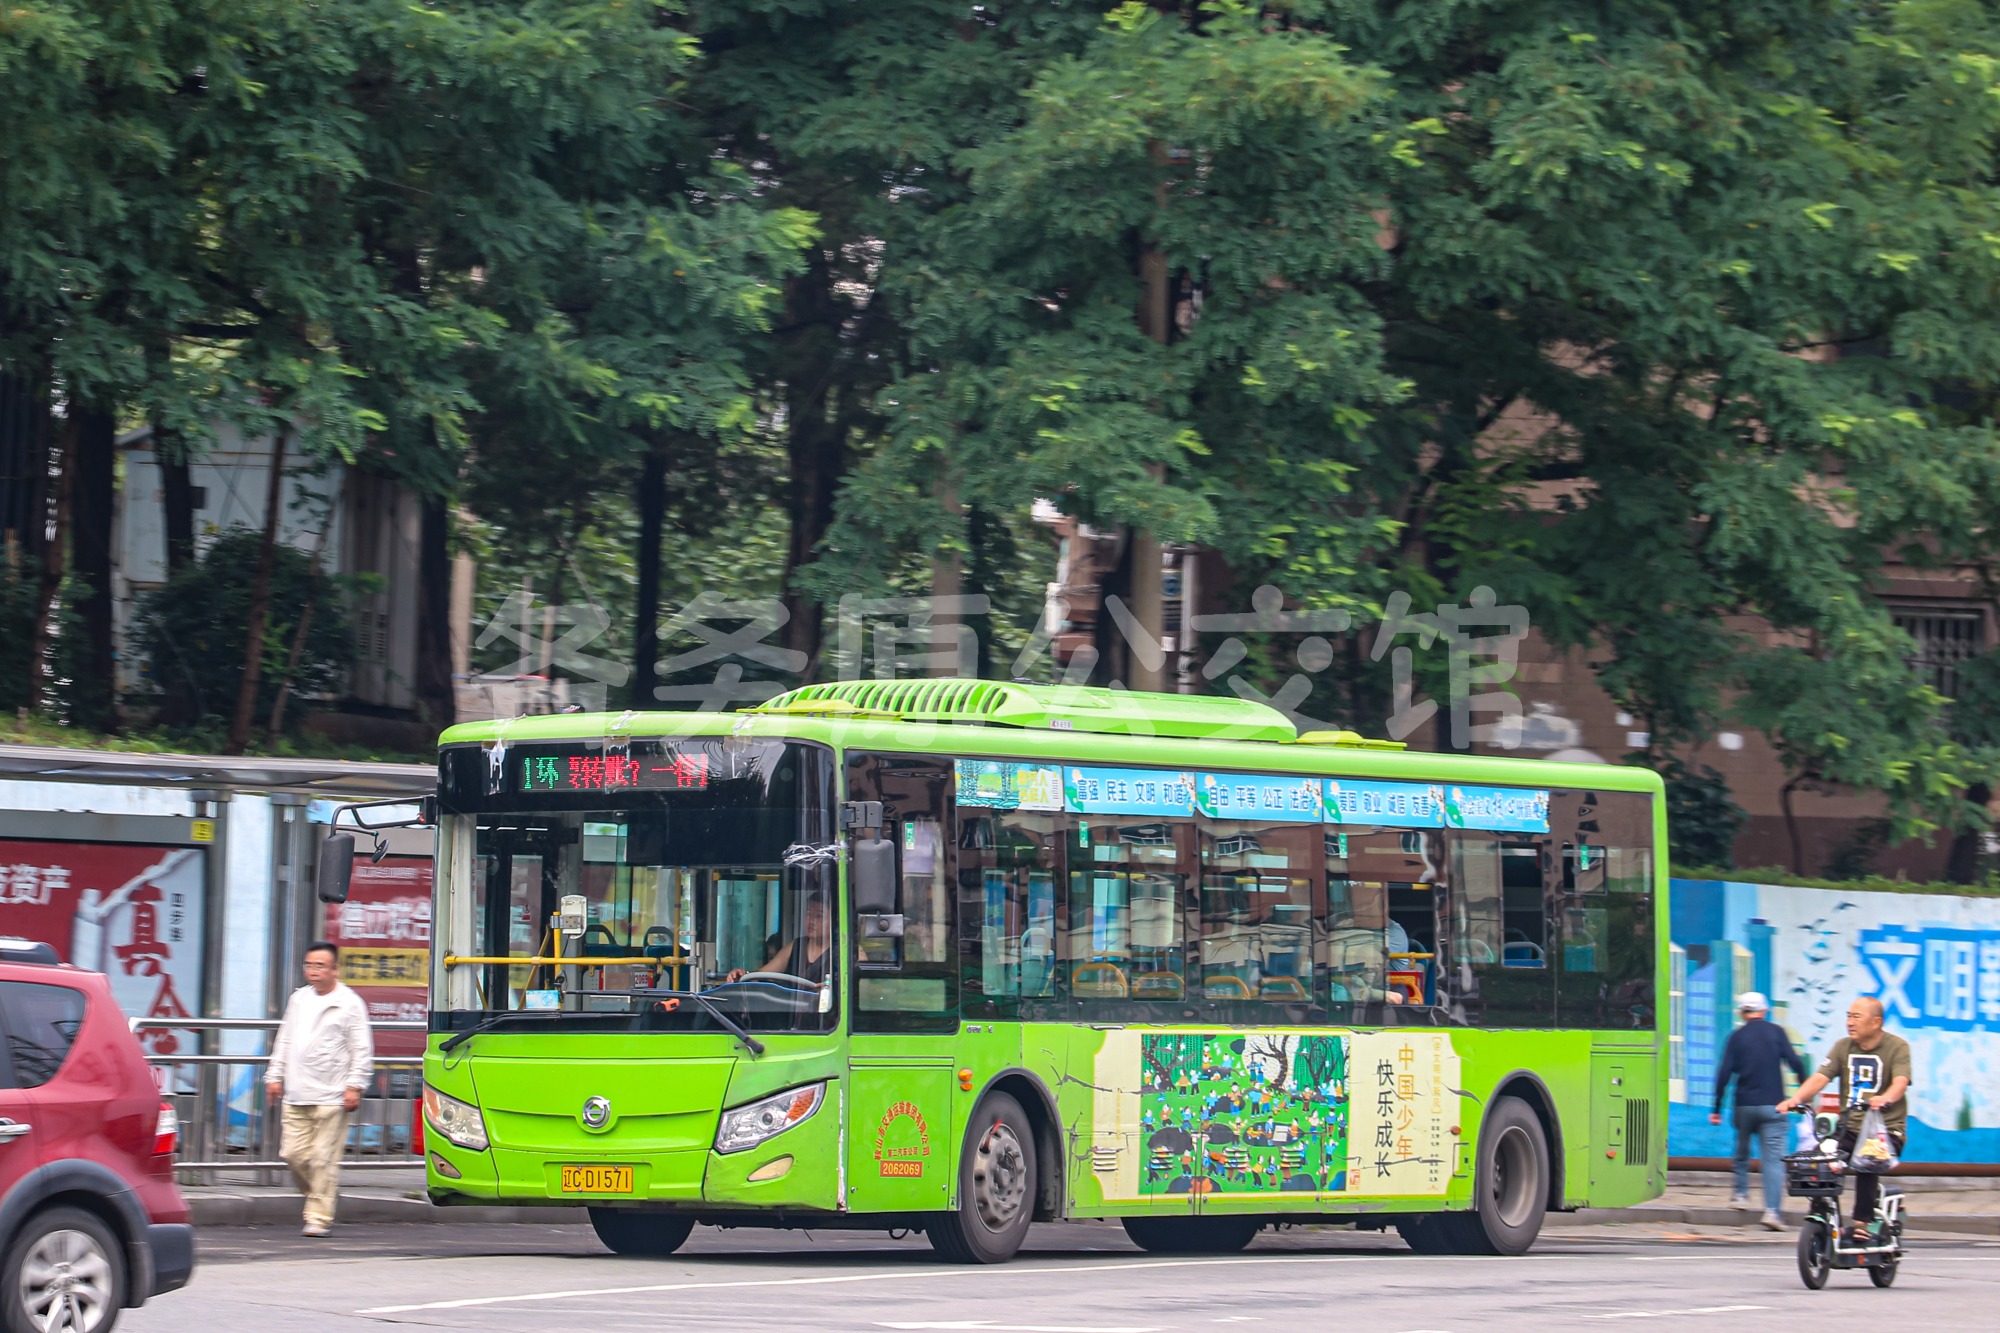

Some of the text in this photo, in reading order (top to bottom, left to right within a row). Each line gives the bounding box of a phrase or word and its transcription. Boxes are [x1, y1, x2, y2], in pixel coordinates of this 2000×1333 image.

[1077, 780, 1099, 801] 富强
[1107, 781, 1127, 802] 民主
[1135, 782, 1155, 803] 文明
[1163, 783, 1183, 804] 和谐
[1210, 785, 1309, 810] 自由 平等 公正 法治
[1339, 792, 1429, 816] 爱国 敬业 诚信 友善
[1846, 1054, 1883, 1107] P
[1396, 1042, 1414, 1160] 中国少年
[1374, 1058, 1396, 1178] 快乐成长
[882, 1163, 920, 1175] 2062069
